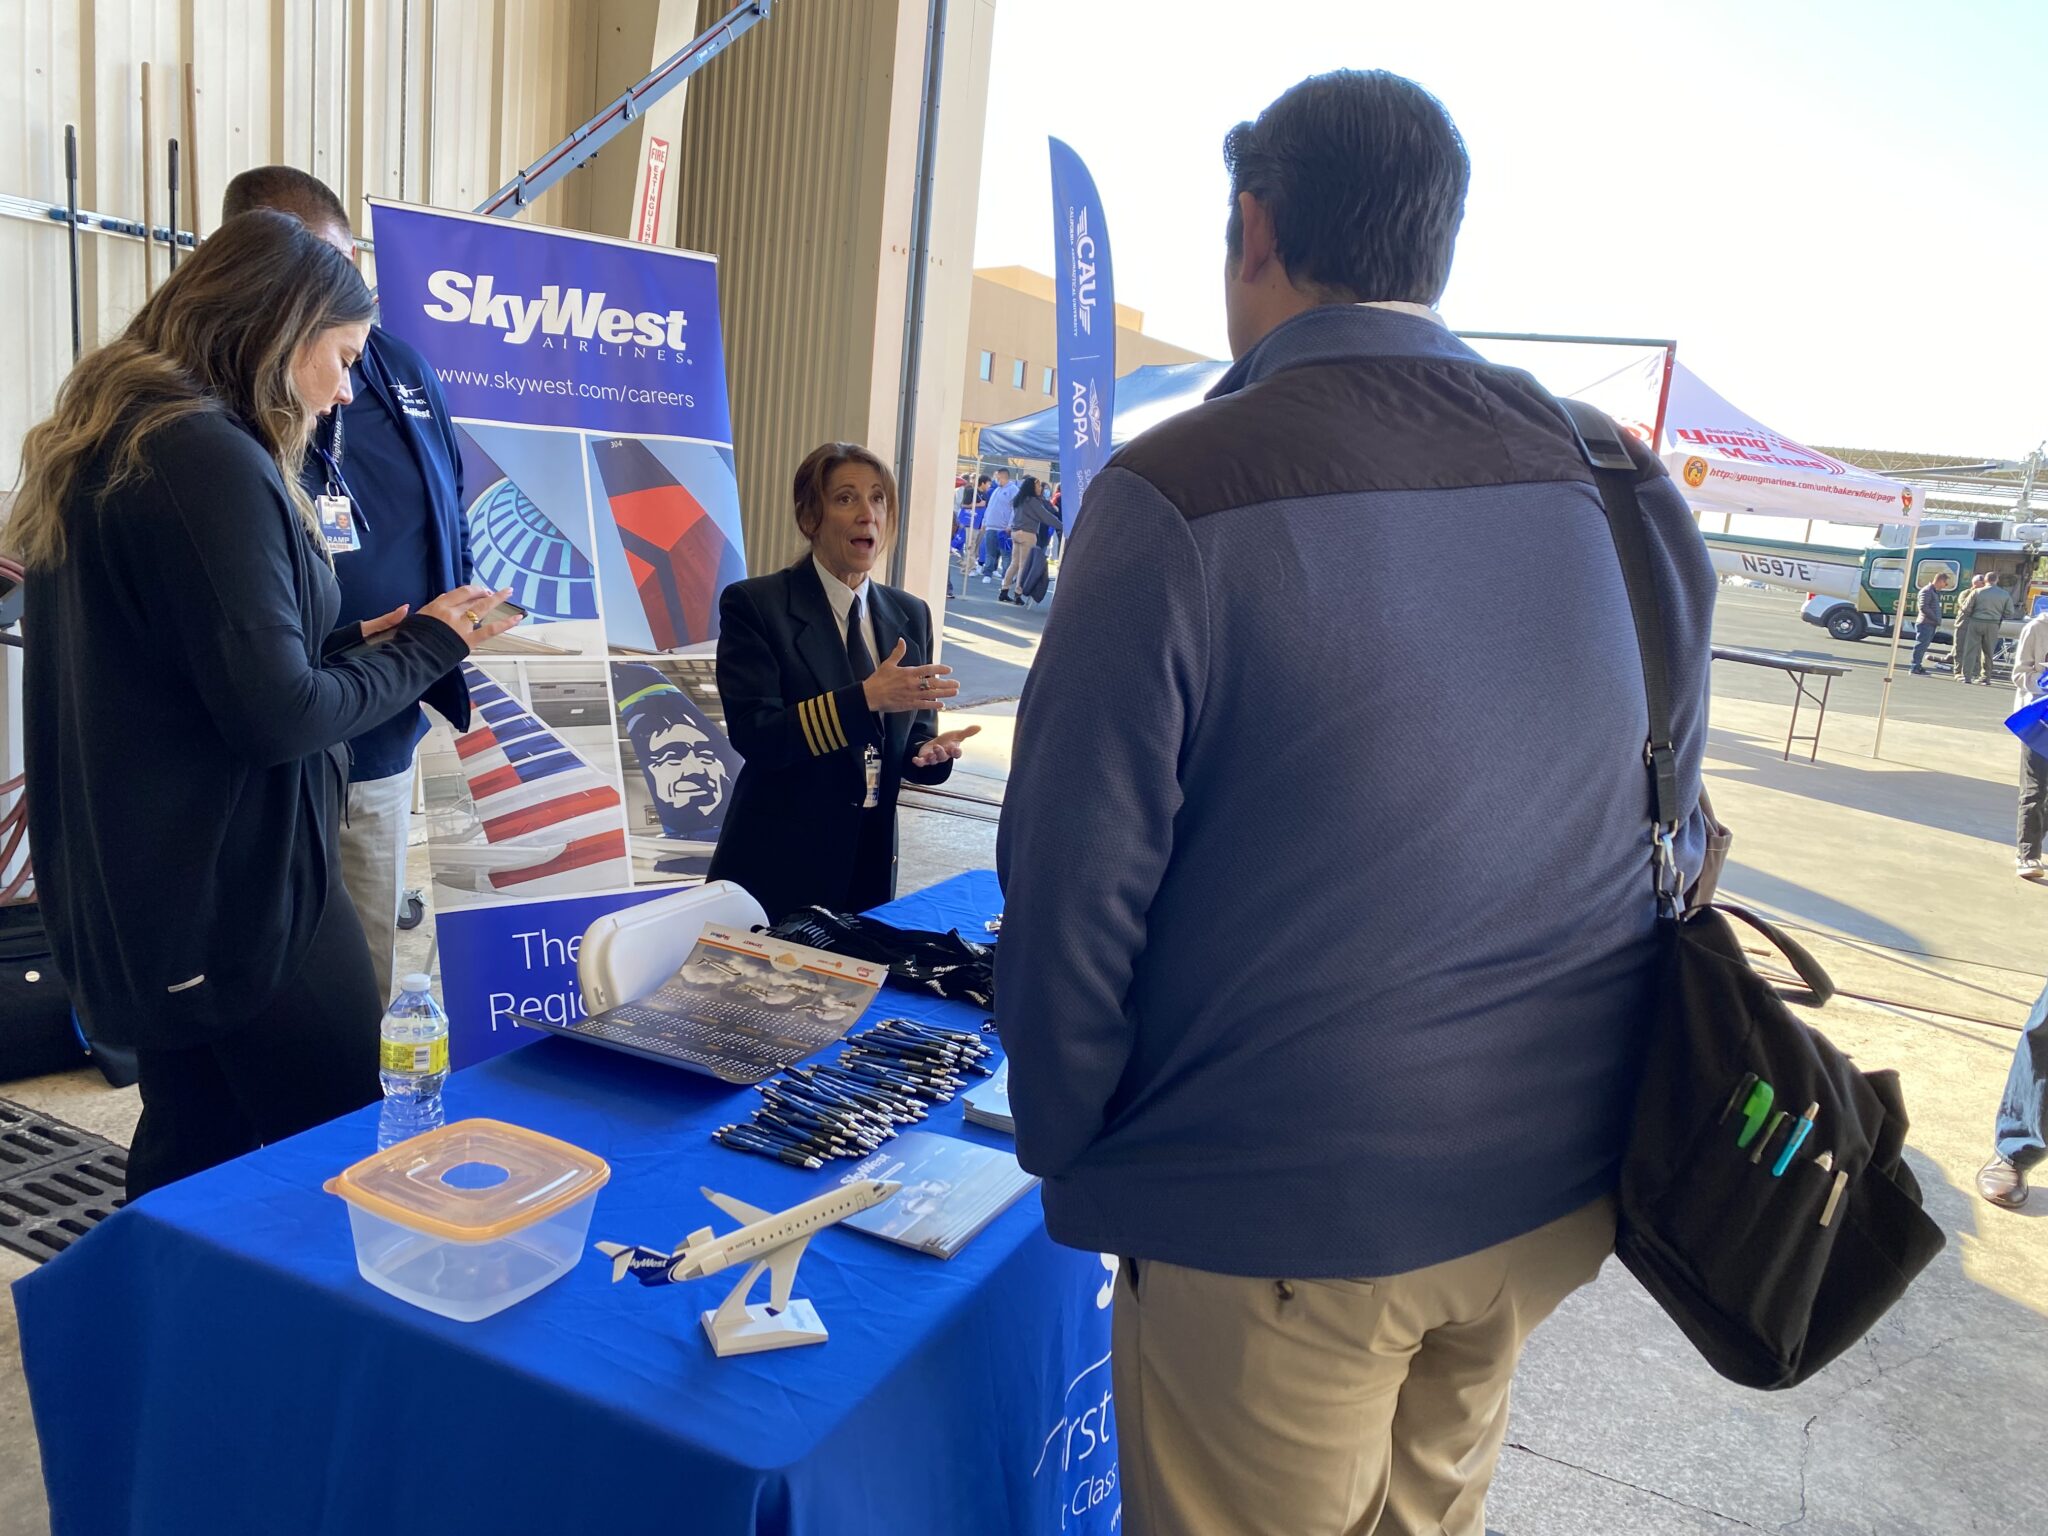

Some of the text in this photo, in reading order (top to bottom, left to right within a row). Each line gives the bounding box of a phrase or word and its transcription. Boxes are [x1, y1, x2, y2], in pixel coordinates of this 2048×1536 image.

[651, 148, 665, 163] FIRE
[1077, 235, 1097, 307] CAU
[423, 269, 688, 351] SkyWest
[542, 337, 686, 364] AIRLINES
[435, 367, 695, 408] www.skywest.com/careers
[1072, 381, 1089, 449] AOPA
[1676, 428, 1772, 452] Young
[1716, 446, 1827, 471] Marines
[326, 535, 350, 544] RAMP
[1741, 554, 1811, 582] N597E
[512, 928, 583, 970] The
[840, 1152, 892, 1185] SkyWest
[631, 1257, 669, 1269] kyWest
[1072, 1461, 1117, 1516] Class
